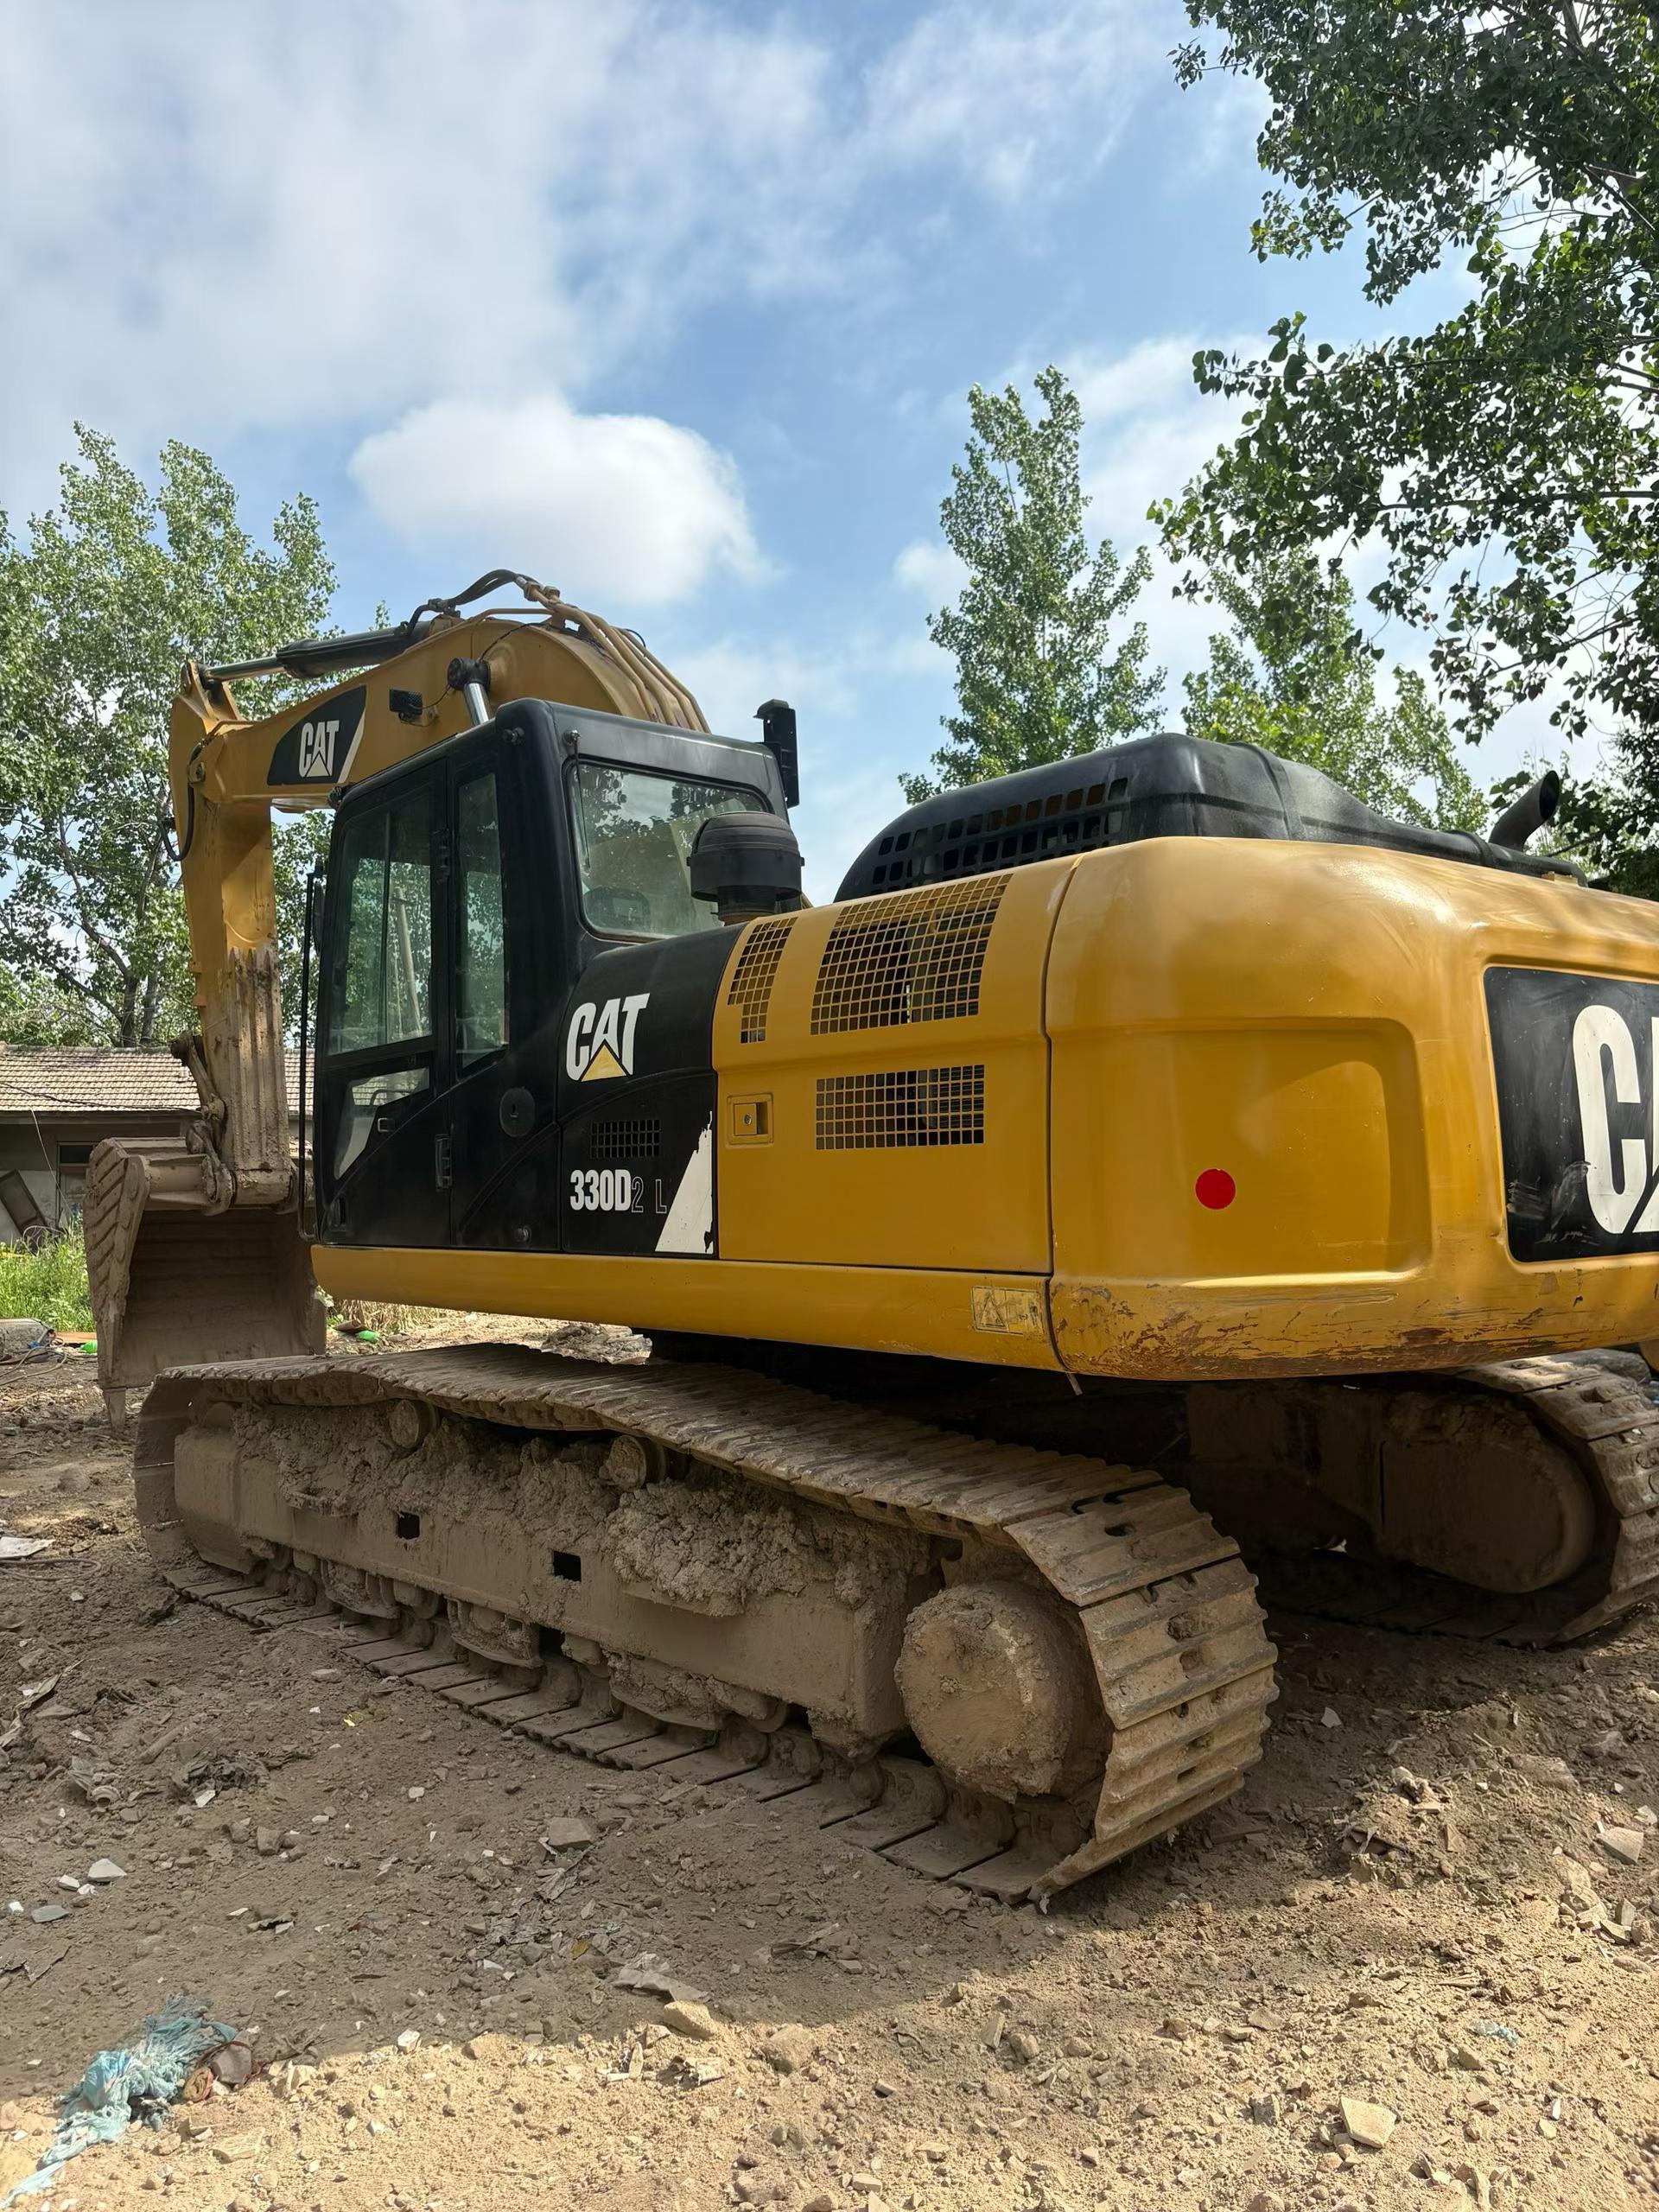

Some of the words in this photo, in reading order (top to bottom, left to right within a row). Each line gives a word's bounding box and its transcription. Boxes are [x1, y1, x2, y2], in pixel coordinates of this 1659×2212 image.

[300, 720, 340, 778] CAT
[566, 993, 650, 1081] CAT
[1573, 1005, 1659, 1234] C
[569, 1169, 644, 1213] 330D2
[655, 1179, 667, 1214] L
